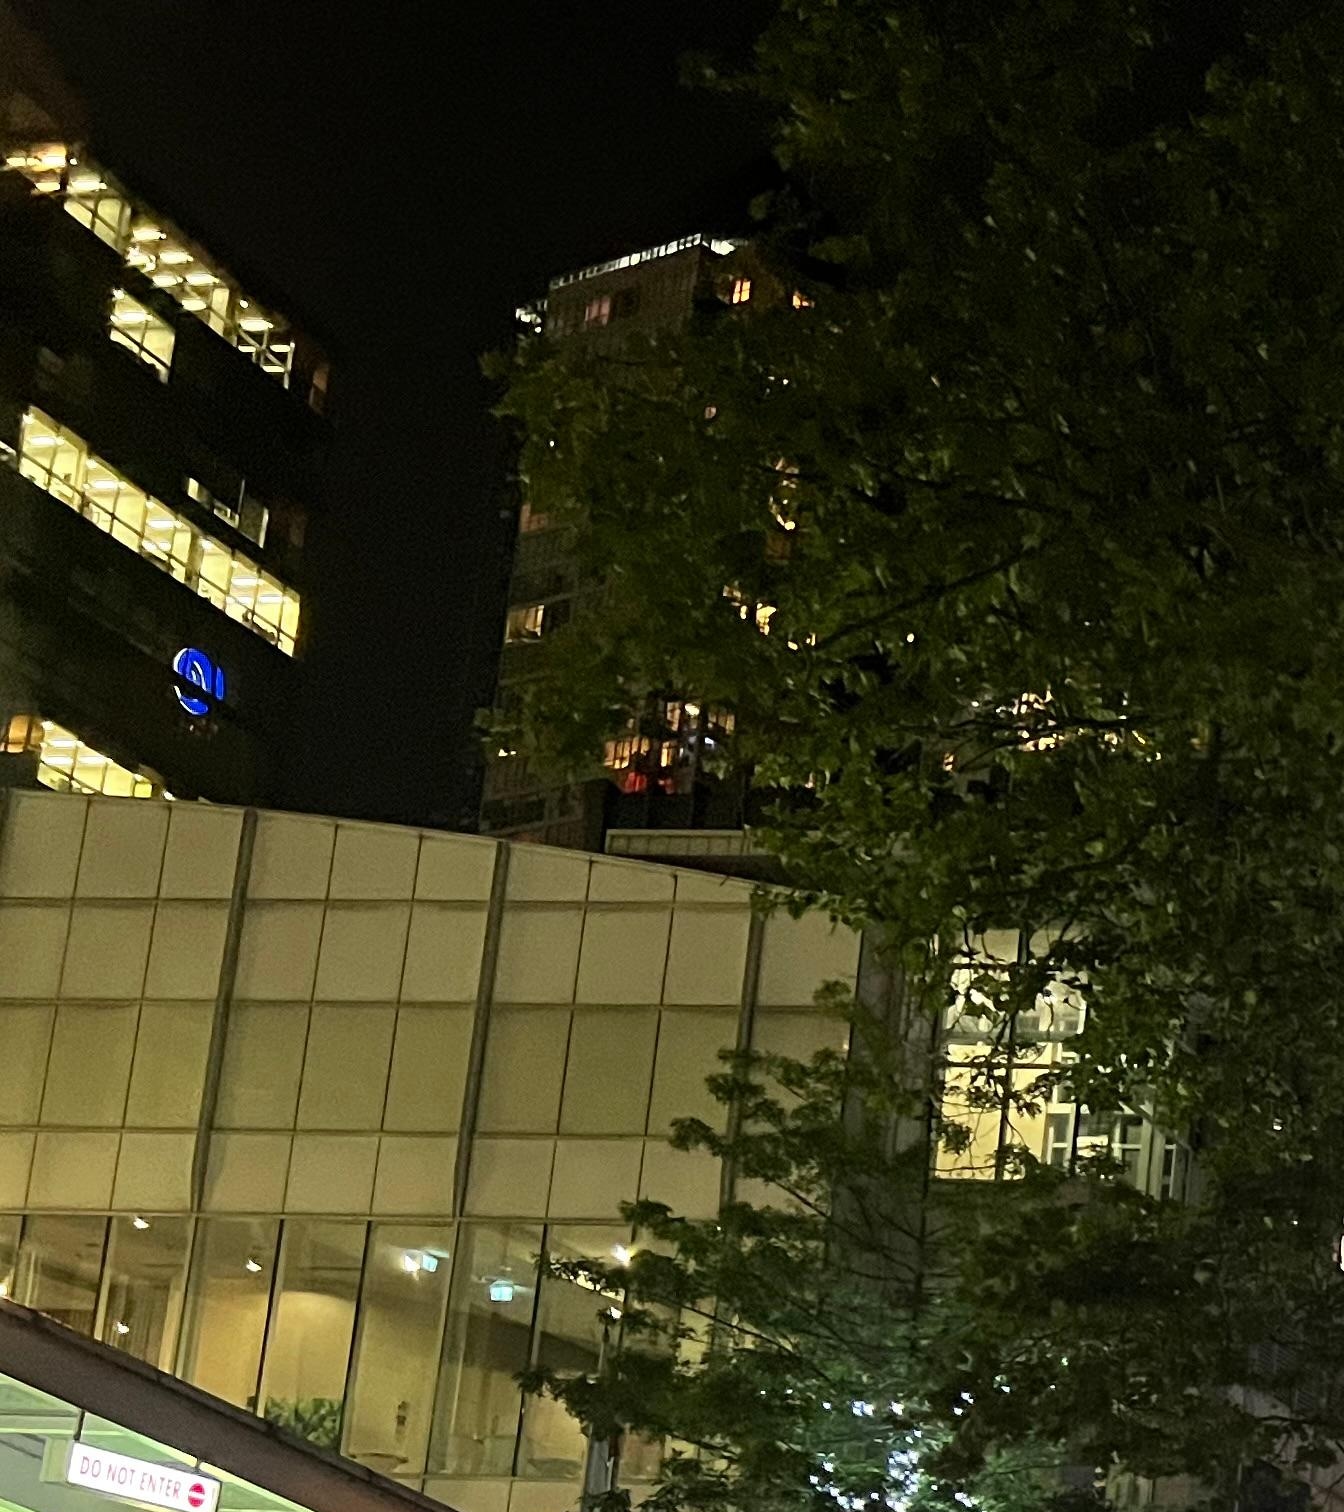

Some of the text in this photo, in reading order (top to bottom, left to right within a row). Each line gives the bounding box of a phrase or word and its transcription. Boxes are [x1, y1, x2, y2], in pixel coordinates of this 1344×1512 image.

[80, 1456, 182, 1499] DO NOT ENTER
